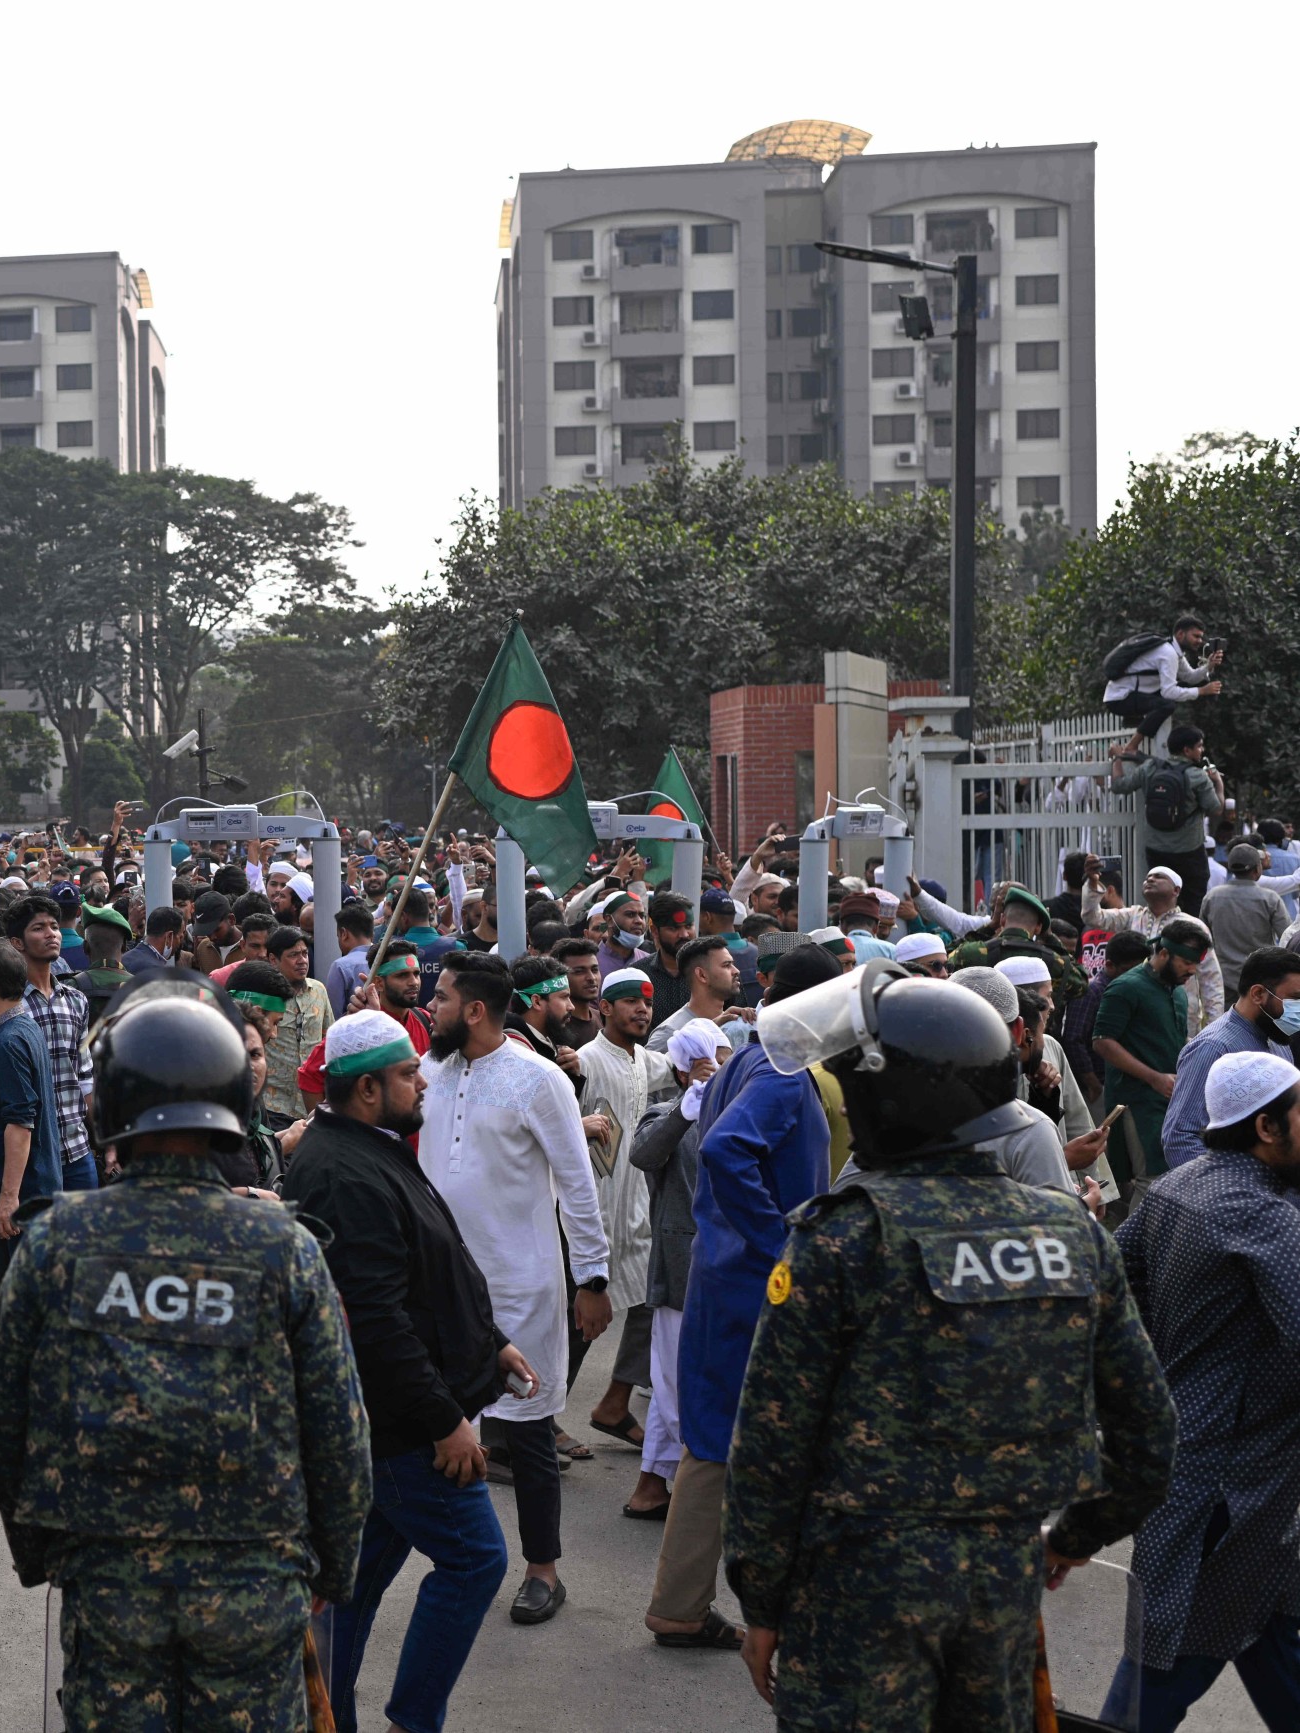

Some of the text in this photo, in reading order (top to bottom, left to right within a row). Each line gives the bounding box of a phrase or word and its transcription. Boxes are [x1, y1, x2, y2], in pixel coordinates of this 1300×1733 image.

[419, 963, 440, 973] ICE
[951, 1238, 1072, 1287] AGB
[96, 1272, 235, 1326] AGB
